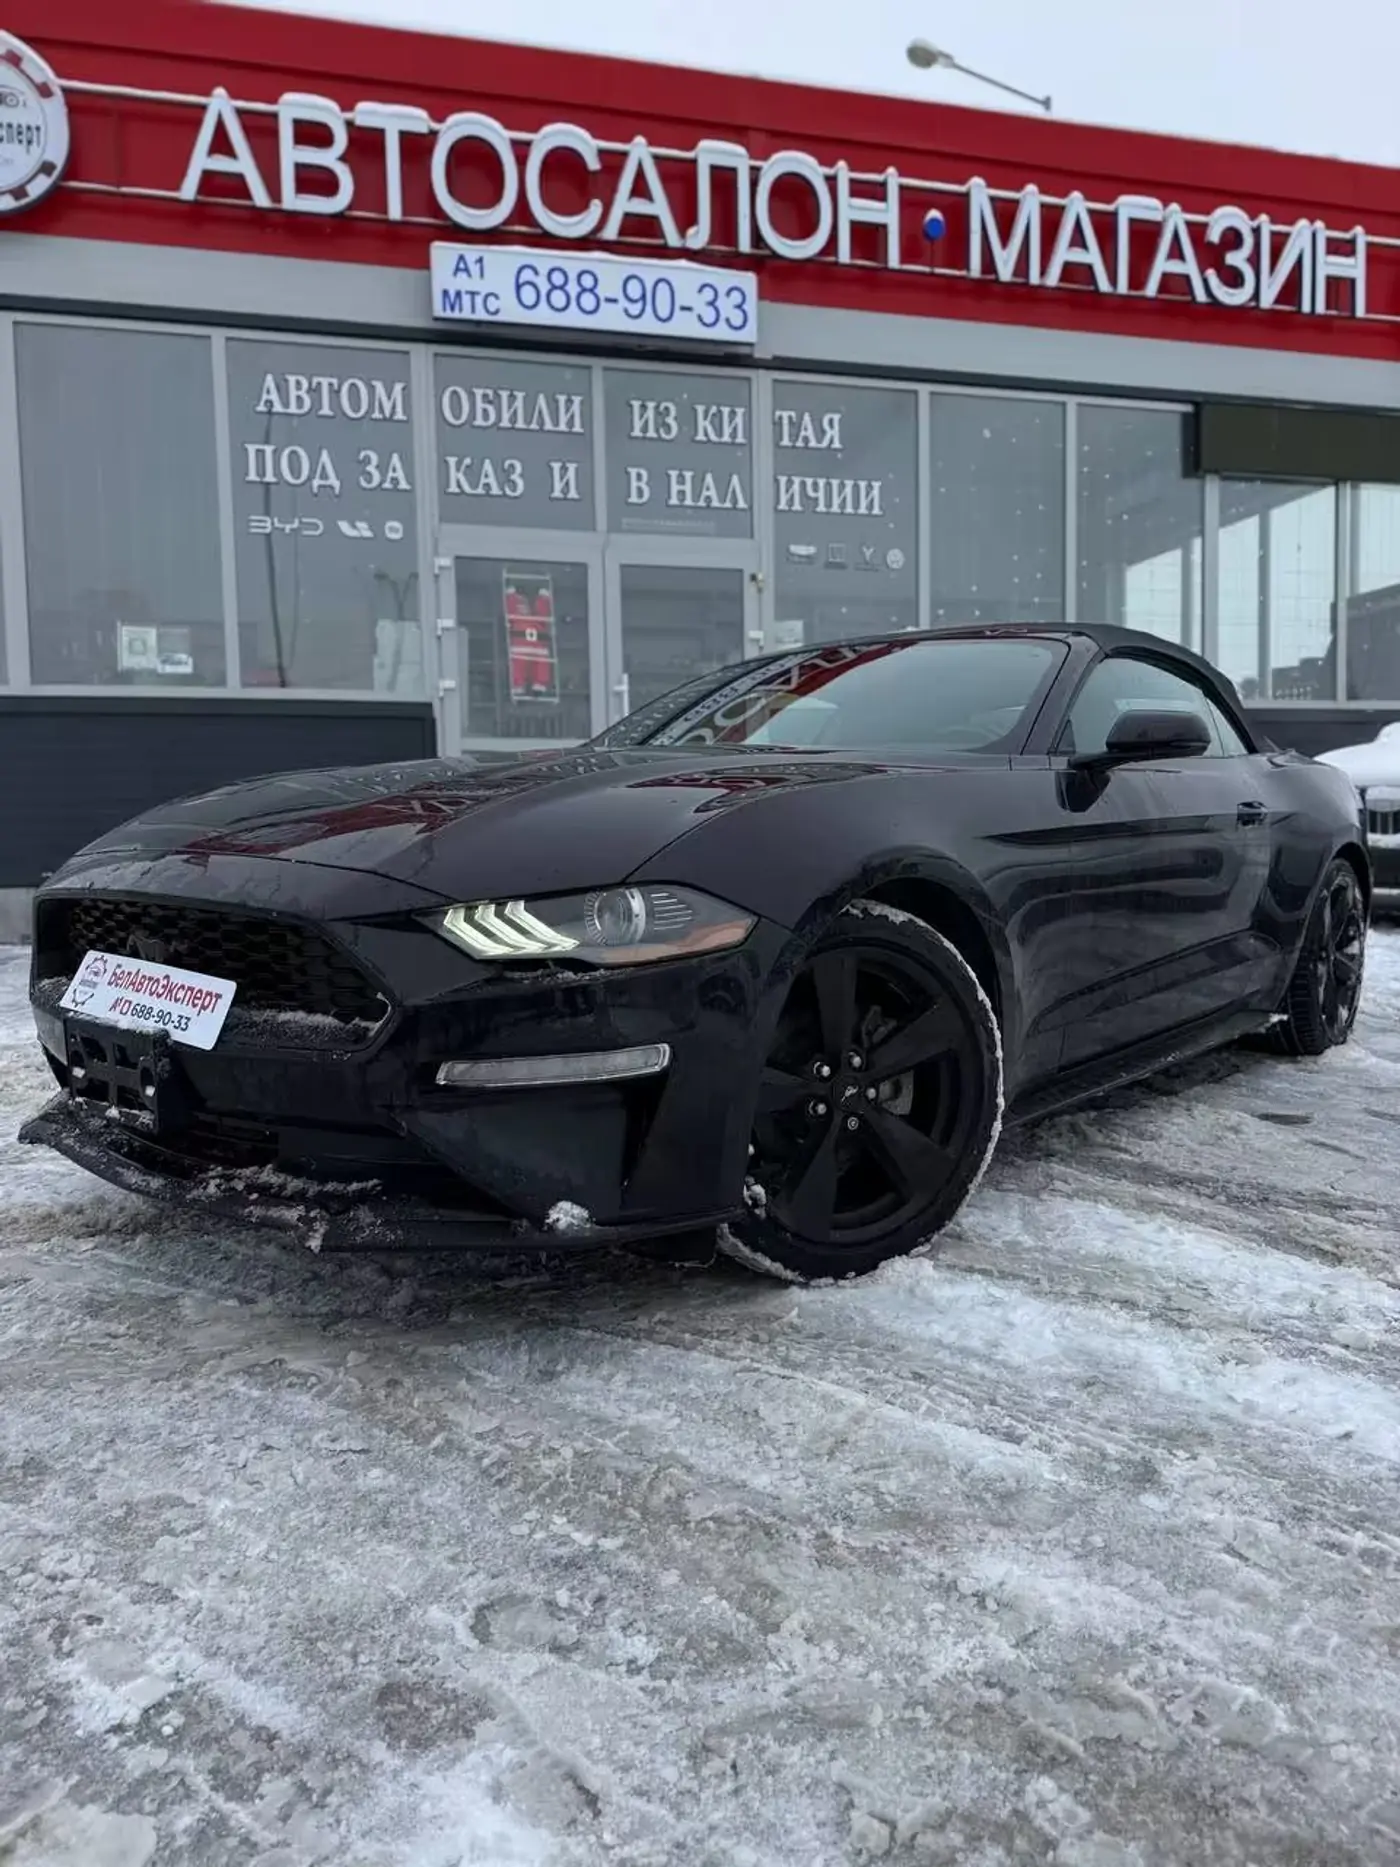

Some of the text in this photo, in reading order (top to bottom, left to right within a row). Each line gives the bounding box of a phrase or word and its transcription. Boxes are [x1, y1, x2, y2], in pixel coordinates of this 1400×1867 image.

[180, 86, 1366, 318] АВТОСАЛОН МАГАЗИН
[452, 254, 485, 280] A1
[441, 289, 501, 316] МТС
[514, 263, 749, 332] 688-90-33
[629, 398, 679, 441] ИЗ
[243, 443, 341, 496] ПОД
[548, 461, 582, 501] И
[625, 466, 651, 505] В
[248, 514, 324, 537] BYD
[106, 963, 223, 1016] БелАвтоЭксперт
[130, 1003, 192, 1033] 688-90-33
